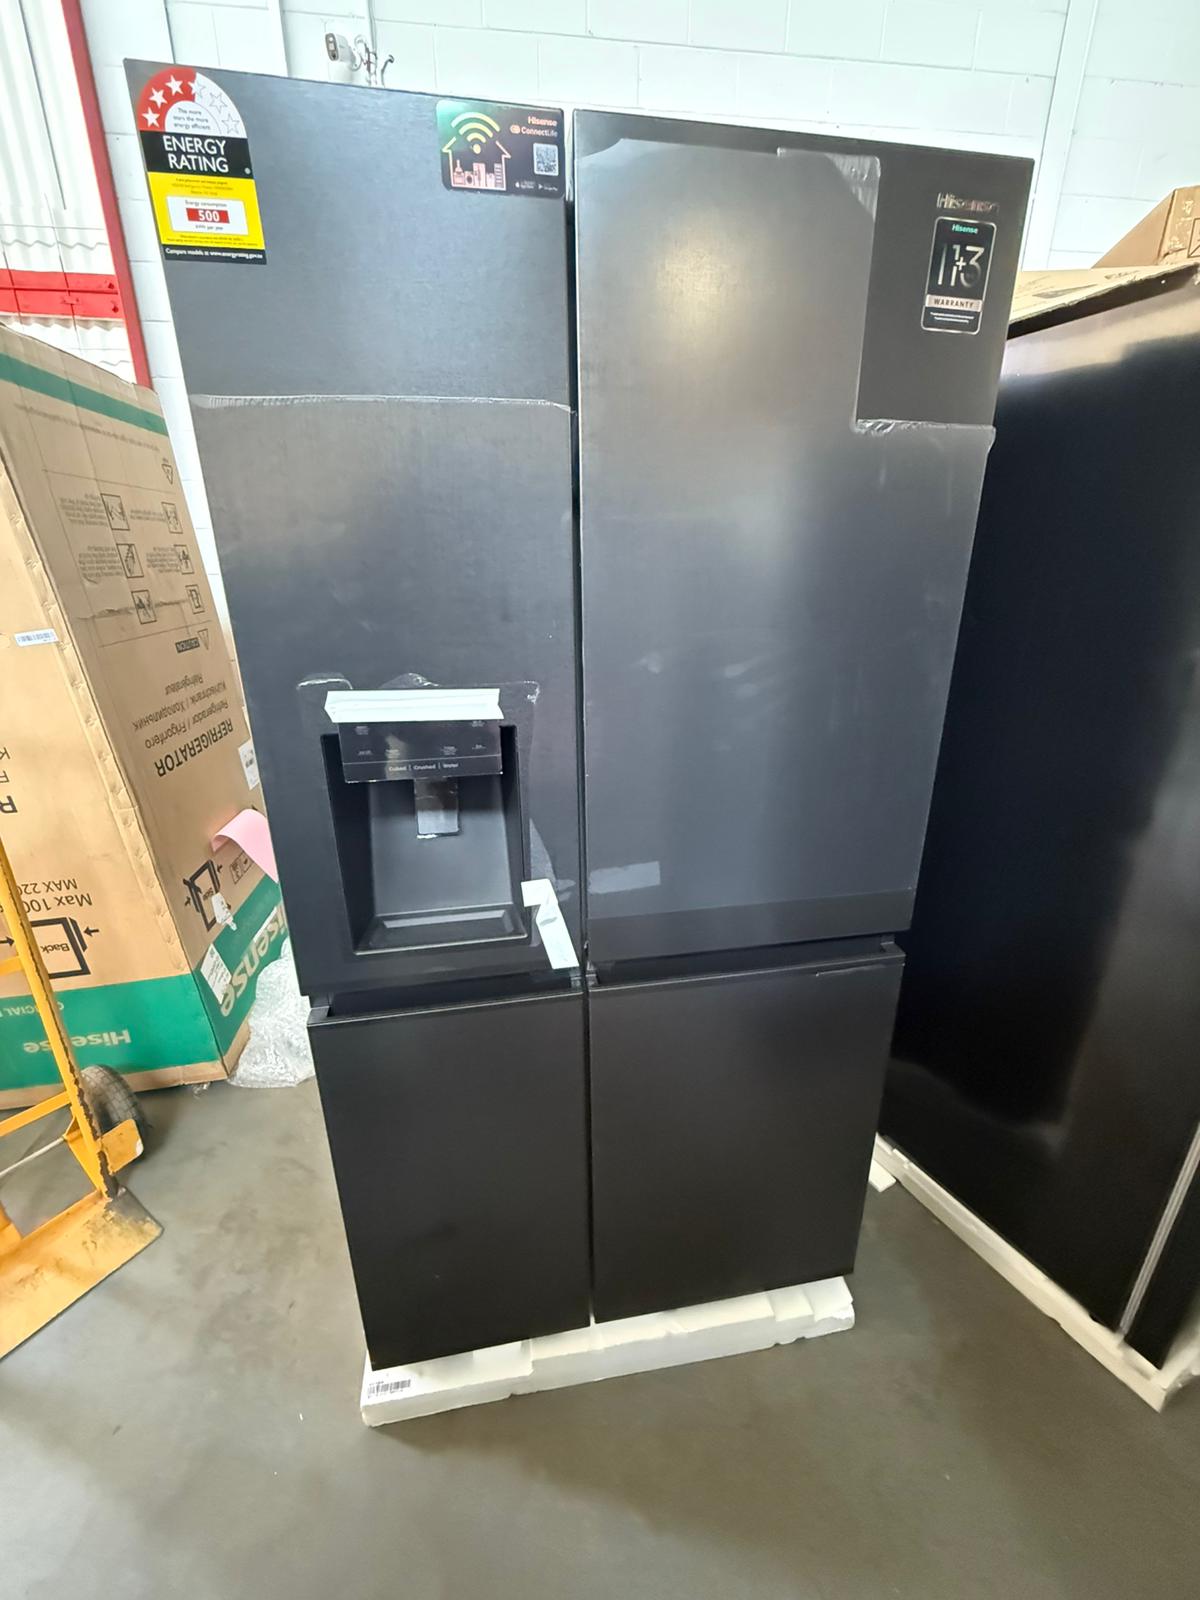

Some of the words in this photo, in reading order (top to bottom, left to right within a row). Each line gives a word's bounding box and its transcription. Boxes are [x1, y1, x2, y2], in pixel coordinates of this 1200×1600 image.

[528, 116, 558, 126] Hisense
[521, 126, 558, 138] ConnectLife
[162, 135, 227, 155] ENERGY
[168, 154, 229, 174] RATING
[198, 210, 220, 222] 500
[952, 224, 978, 234] Hisense
[934, 298, 974, 309] WARRANTY
[154, 718, 234, 778] REFRIGERATOR
[42, 878, 78, 892] MAX
[54, 892, 93, 908] Max
[40, 942, 70, 954] Back
[23, 1029, 132, 1054] Hisese
